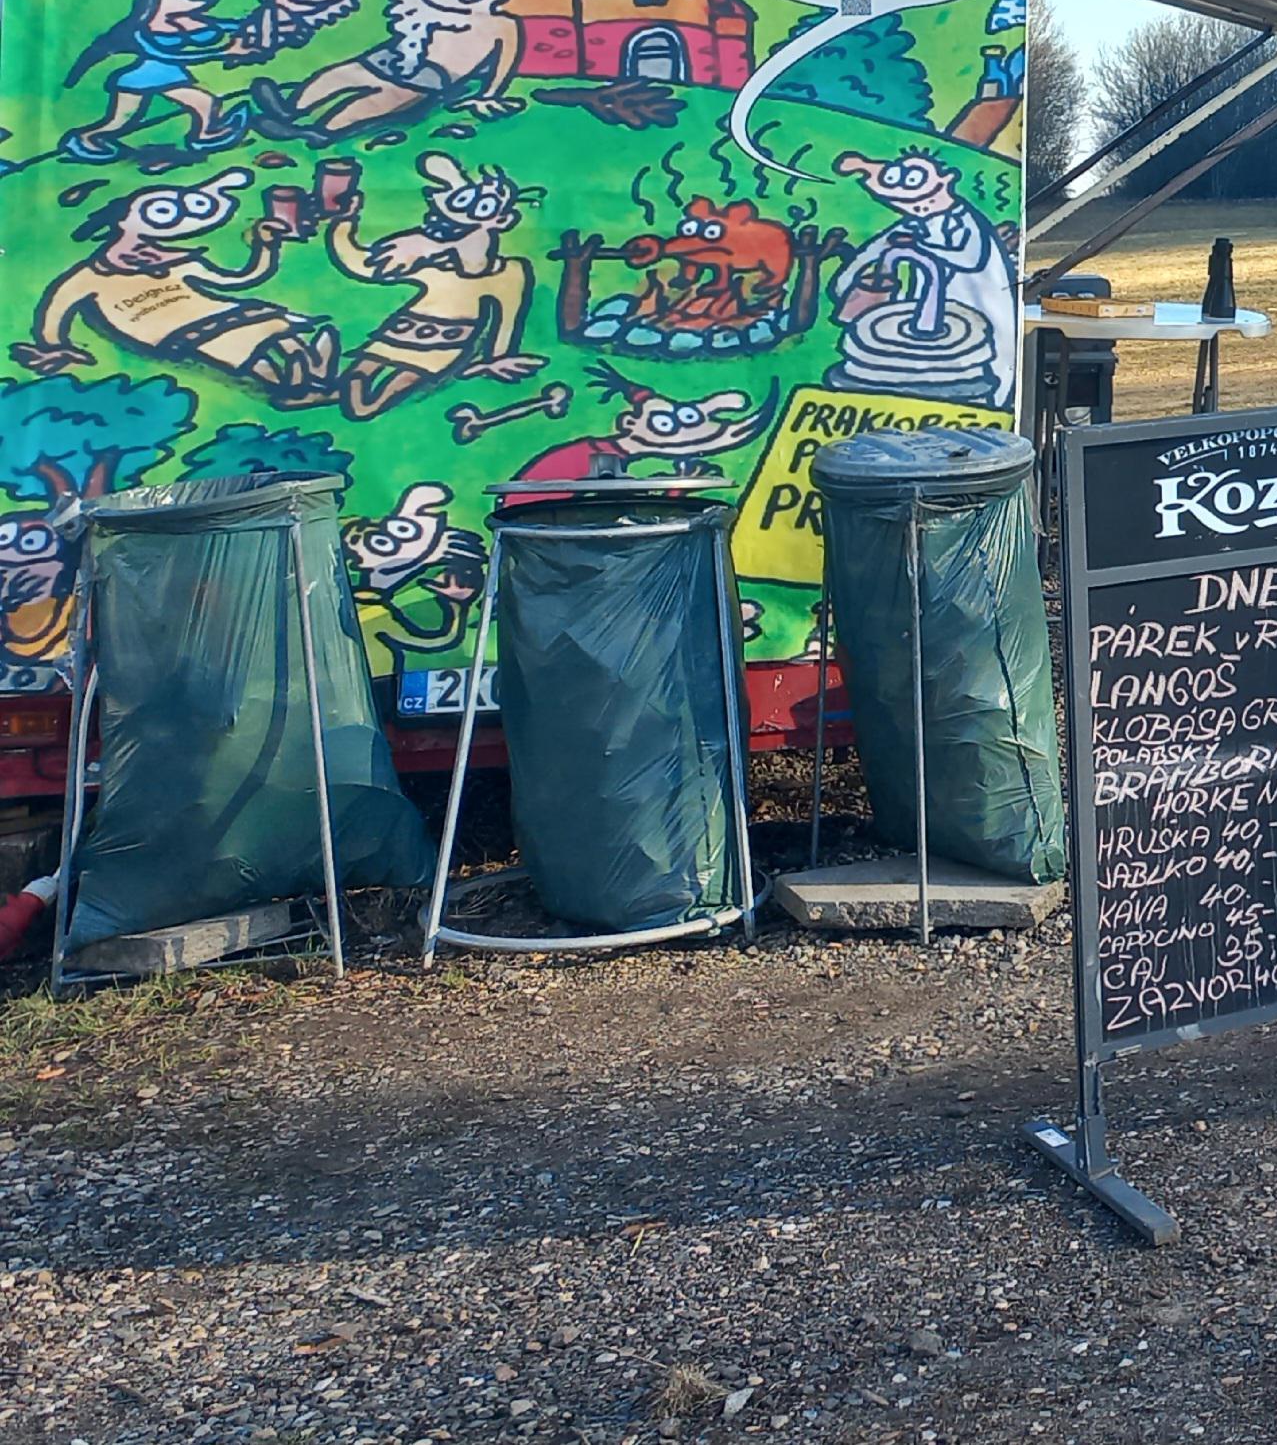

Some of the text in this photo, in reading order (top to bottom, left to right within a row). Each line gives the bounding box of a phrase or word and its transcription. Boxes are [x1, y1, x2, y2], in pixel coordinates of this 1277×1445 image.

[1238, 443, 1277, 459] 1874
[1090, 605, 1221, 664] PÁREK
[1090, 653, 1241, 710] LANGOŠ
[403, 697, 424, 709] CZ
[1092, 706, 1236, 745] KLOBÁSA
[1096, 856, 1207, 890] JABLKO
[1097, 890, 1169, 931] KÁVA
[1103, 954, 1168, 990] ČAJ
